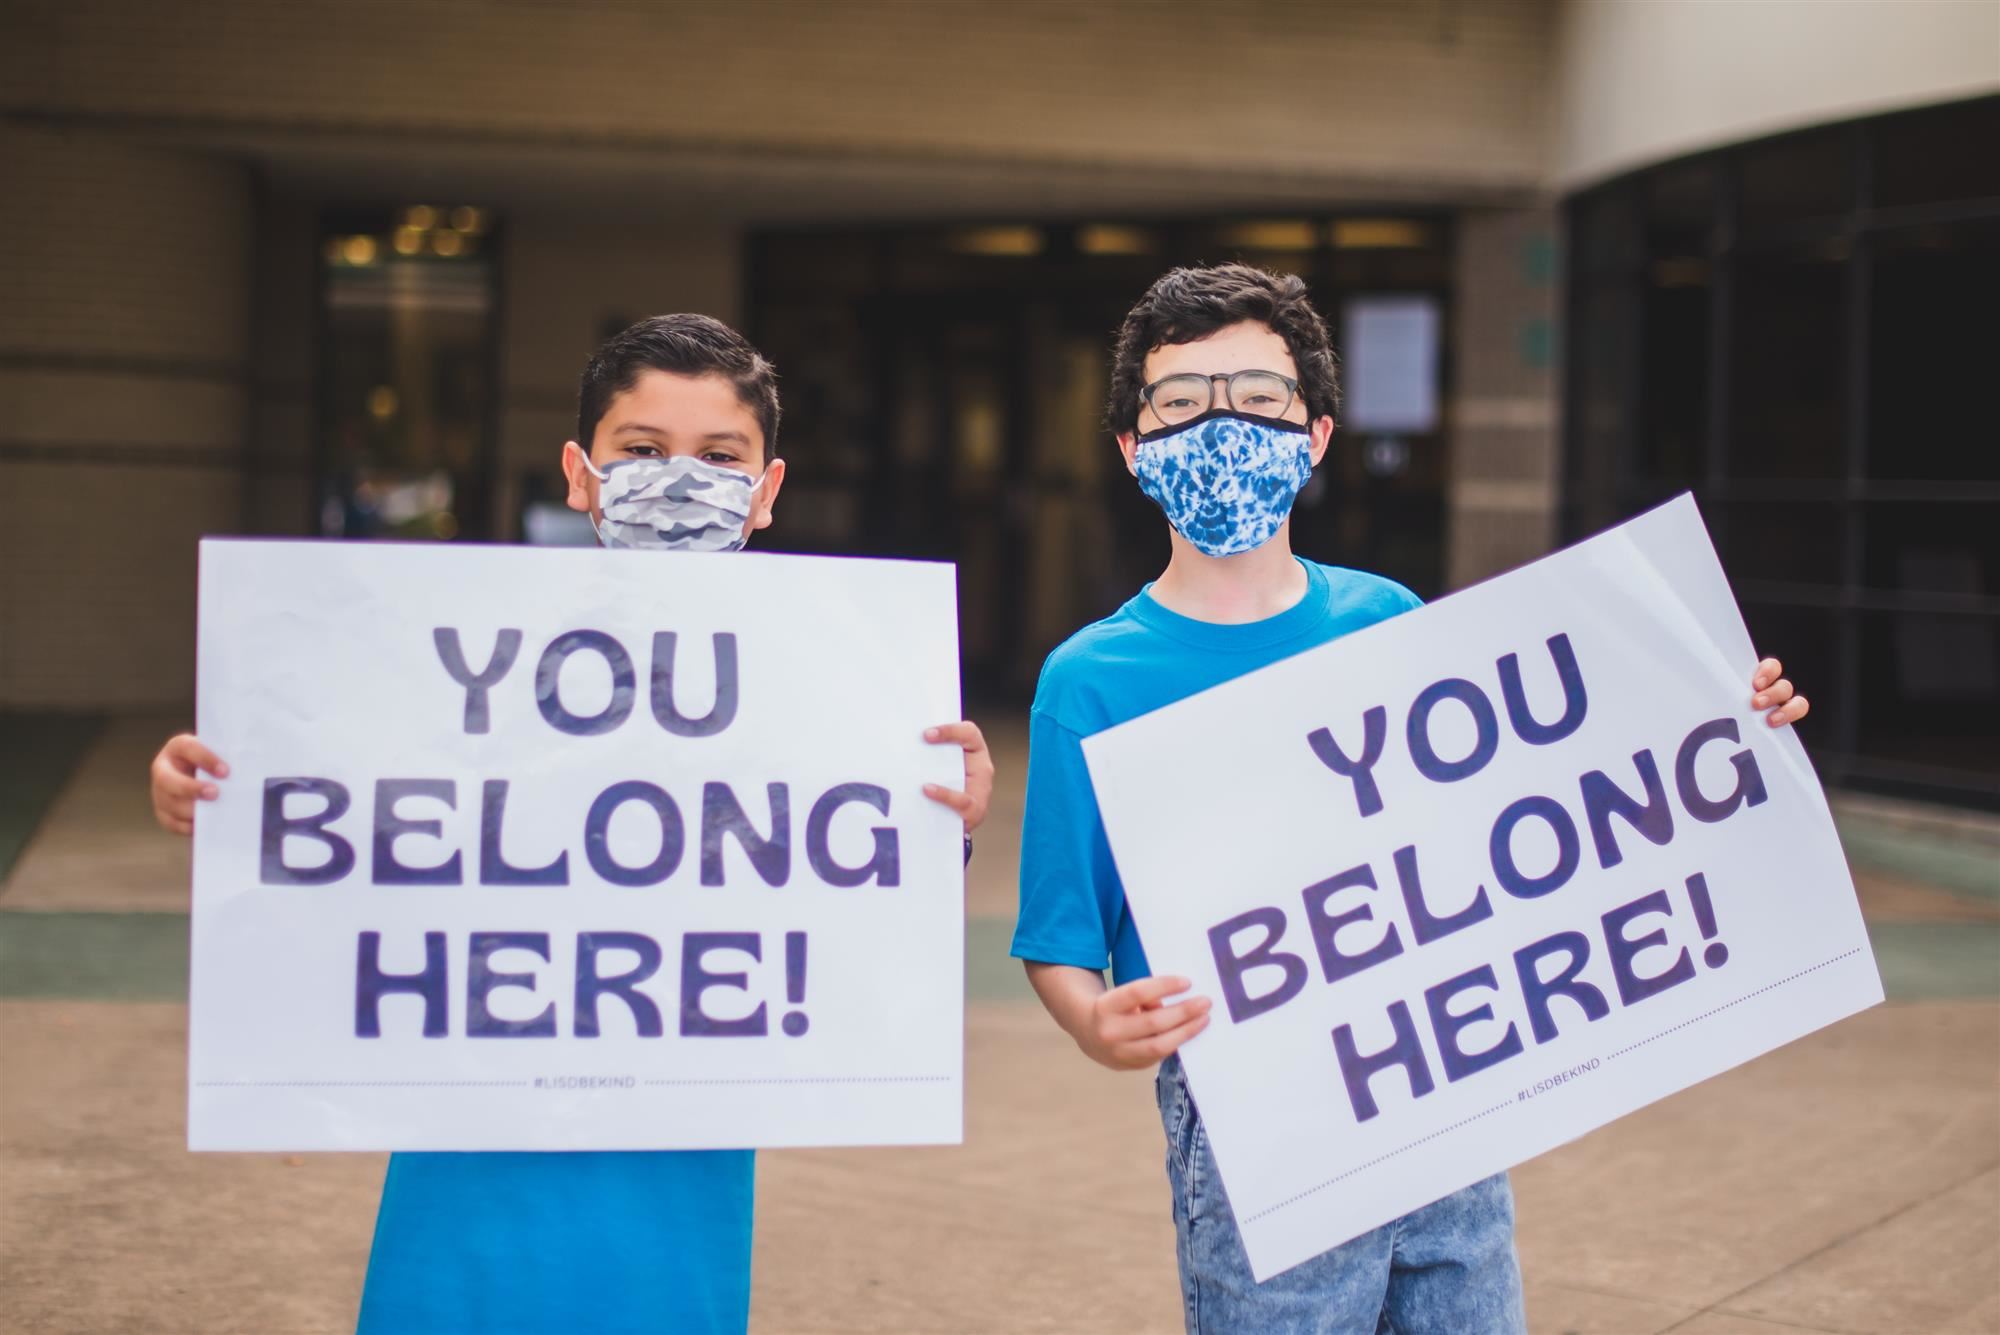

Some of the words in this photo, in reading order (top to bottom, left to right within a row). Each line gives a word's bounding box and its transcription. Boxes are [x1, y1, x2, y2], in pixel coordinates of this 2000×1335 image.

[433, 627, 738, 737] YOU
[1307, 632, 1588, 818] YOU
[259, 776, 901, 888] BELONG
[1207, 717, 1769, 1024] BELONG
[354, 930, 810, 1039] HERE!
[1331, 871, 1730, 1123] HERE!
[534, 1076, 636, 1089] #LISDBEKIND
[1517, 1057, 1600, 1102] #LISDBEKIND
